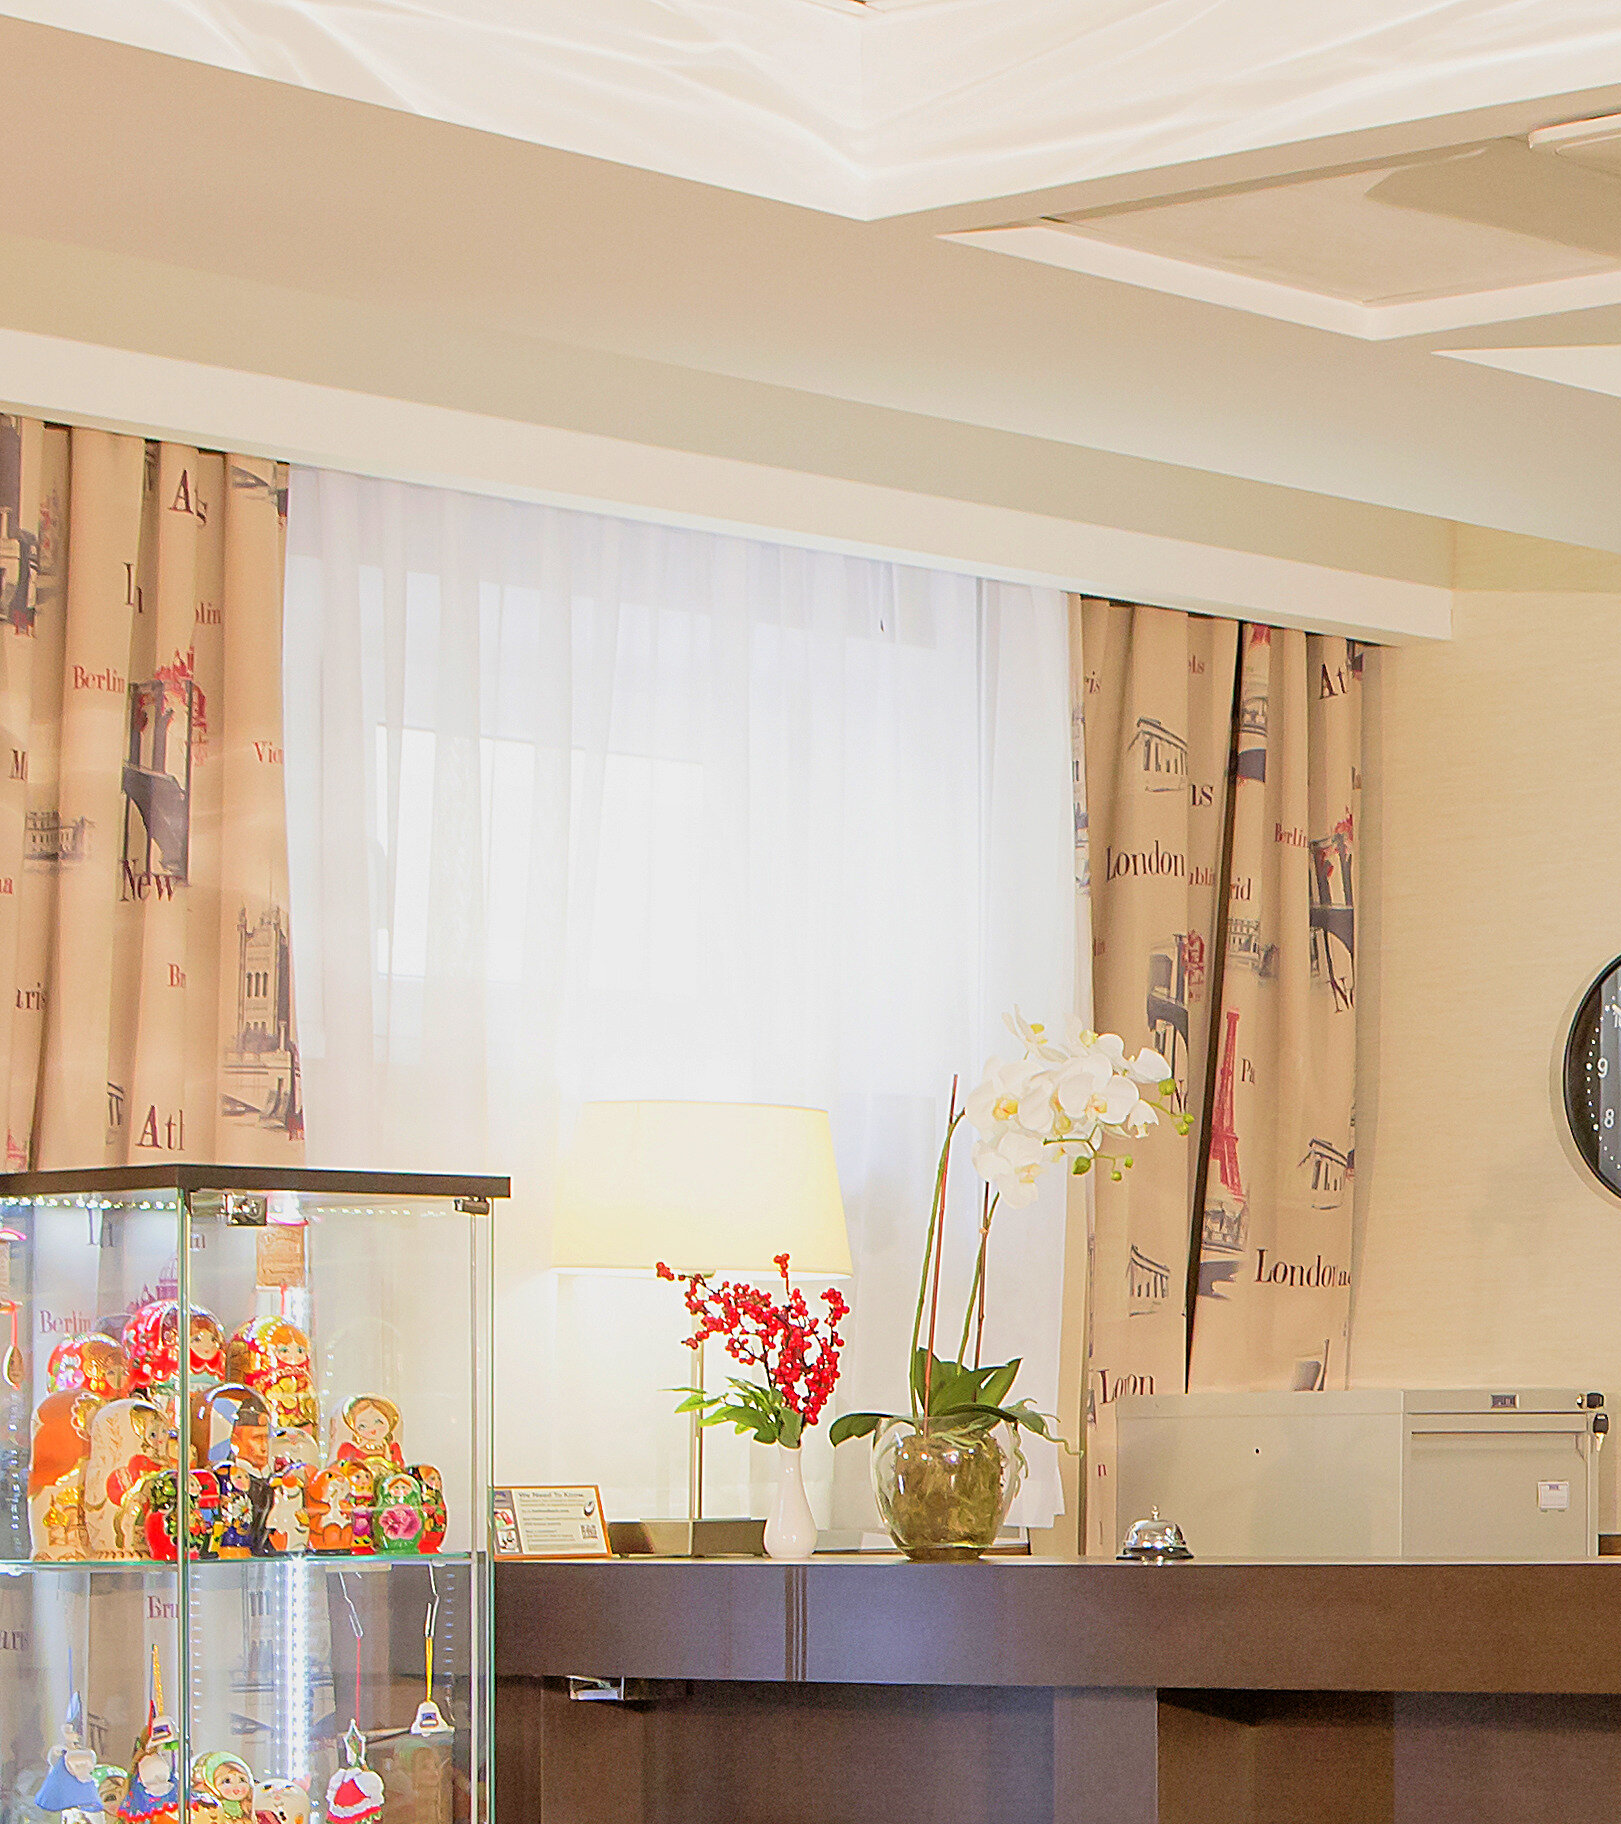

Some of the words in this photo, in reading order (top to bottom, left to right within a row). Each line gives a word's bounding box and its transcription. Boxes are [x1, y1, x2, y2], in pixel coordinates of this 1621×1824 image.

[72, 665, 126, 694] Berlin
[1105, 839, 1186, 882] London
[119, 858, 176, 902] New
[1597, 1057, 1609, 1079] 9
[1603, 1108, 1615, 1129] 8
